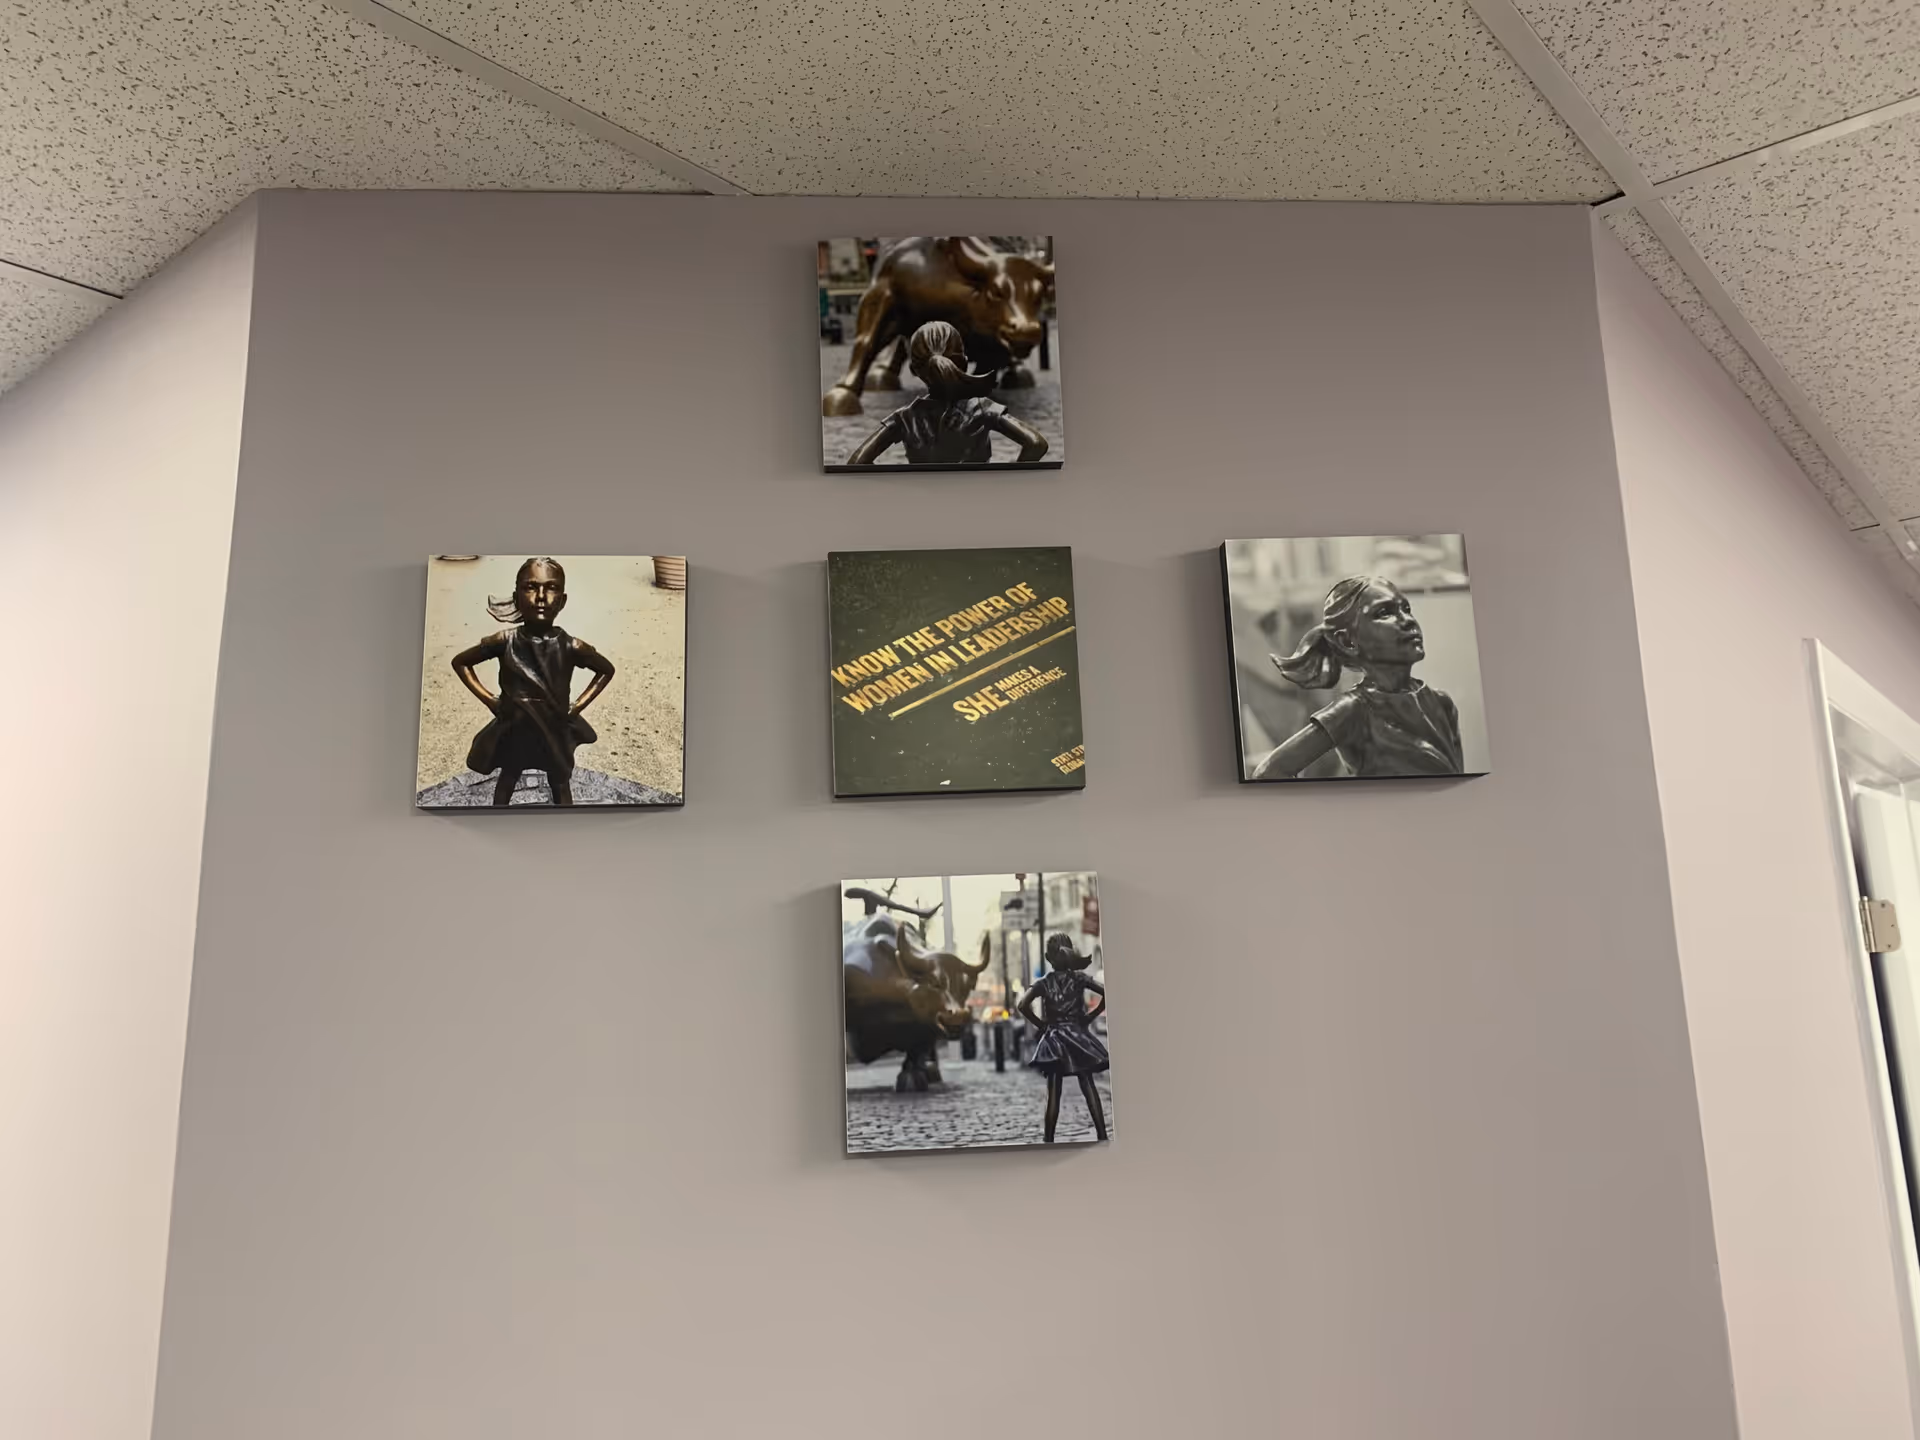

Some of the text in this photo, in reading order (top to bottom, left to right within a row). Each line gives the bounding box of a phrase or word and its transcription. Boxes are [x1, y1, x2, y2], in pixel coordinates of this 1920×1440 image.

[831, 582, 1037, 687] KNOW THE POWER OF
[841, 596, 1070, 713] WOMEN IN LEADERSHIP
[995, 665, 1041, 692] MAKES A
[1005, 666, 1067, 701] DIFFERENCE
[953, 685, 1009, 722] SHE
